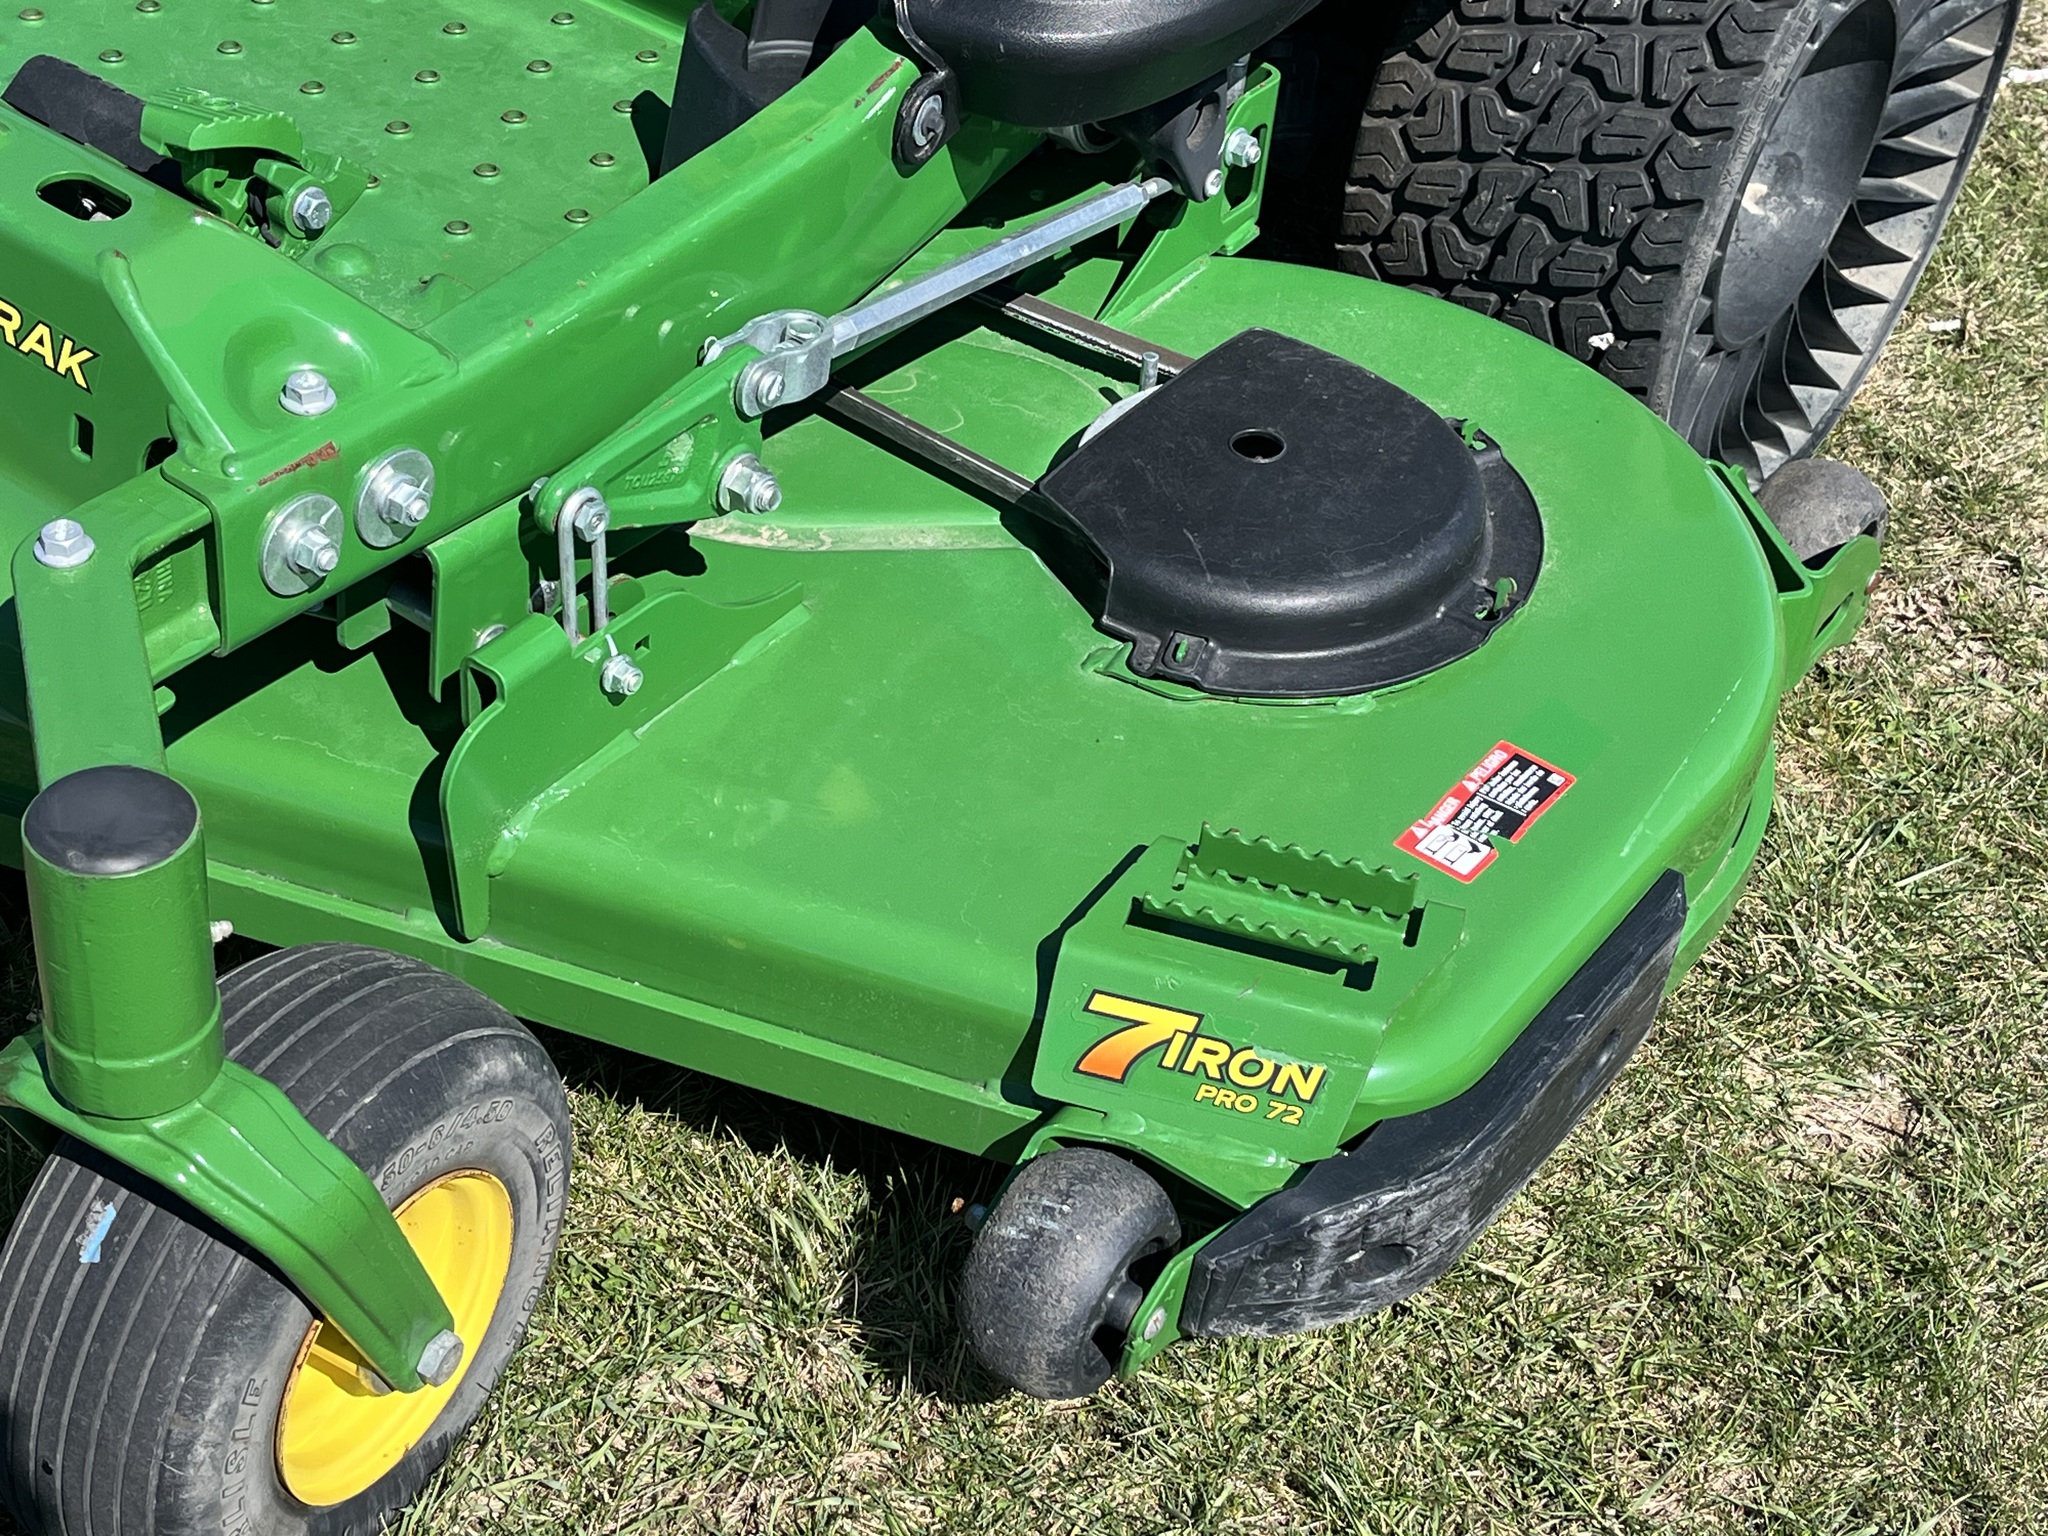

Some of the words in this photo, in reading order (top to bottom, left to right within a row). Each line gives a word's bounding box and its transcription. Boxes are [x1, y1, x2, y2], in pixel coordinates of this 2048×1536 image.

[0, 297, 101, 395] RAK
[1469, 749, 1508, 781] PELIGRO
[1194, 1083, 1259, 1113] PRO
[1264, 1100, 1305, 1126] 72
